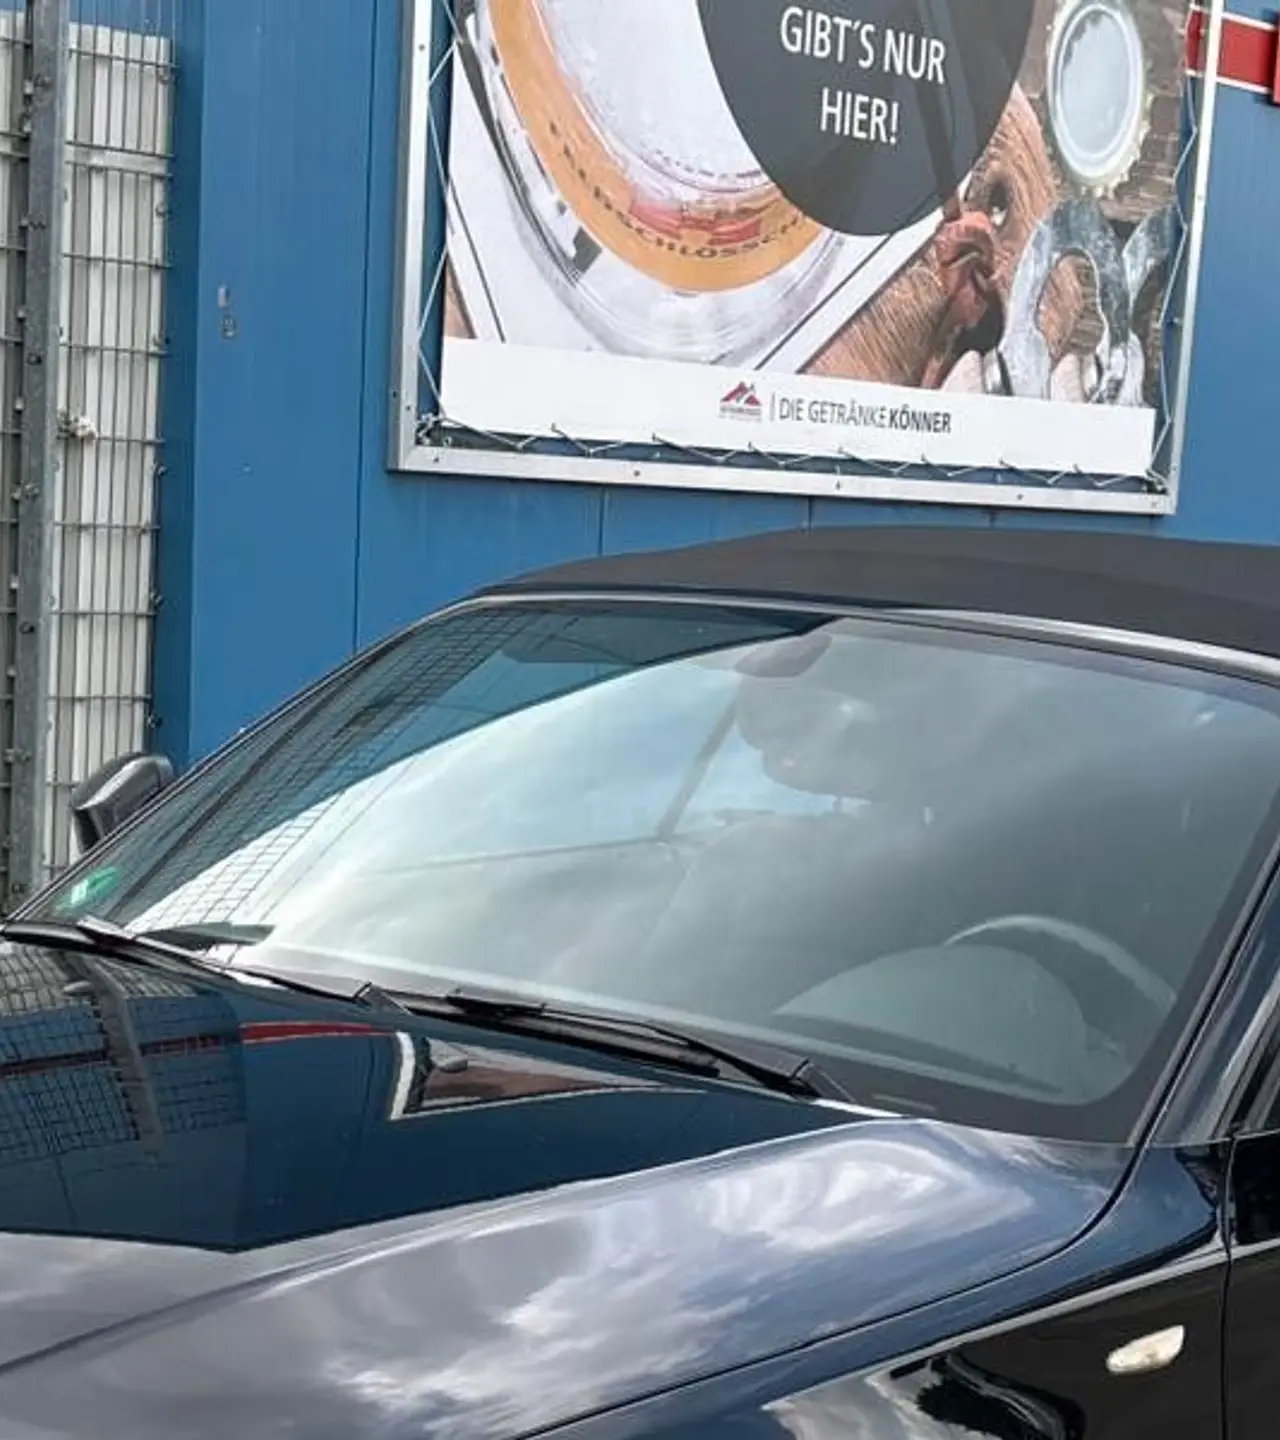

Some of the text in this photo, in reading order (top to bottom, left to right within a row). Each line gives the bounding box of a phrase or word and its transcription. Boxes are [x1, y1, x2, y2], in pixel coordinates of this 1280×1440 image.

[883, 28, 946, 85] NUR
[820, 87, 899, 144] HIER!
[779, 397, 805, 422] DIE
